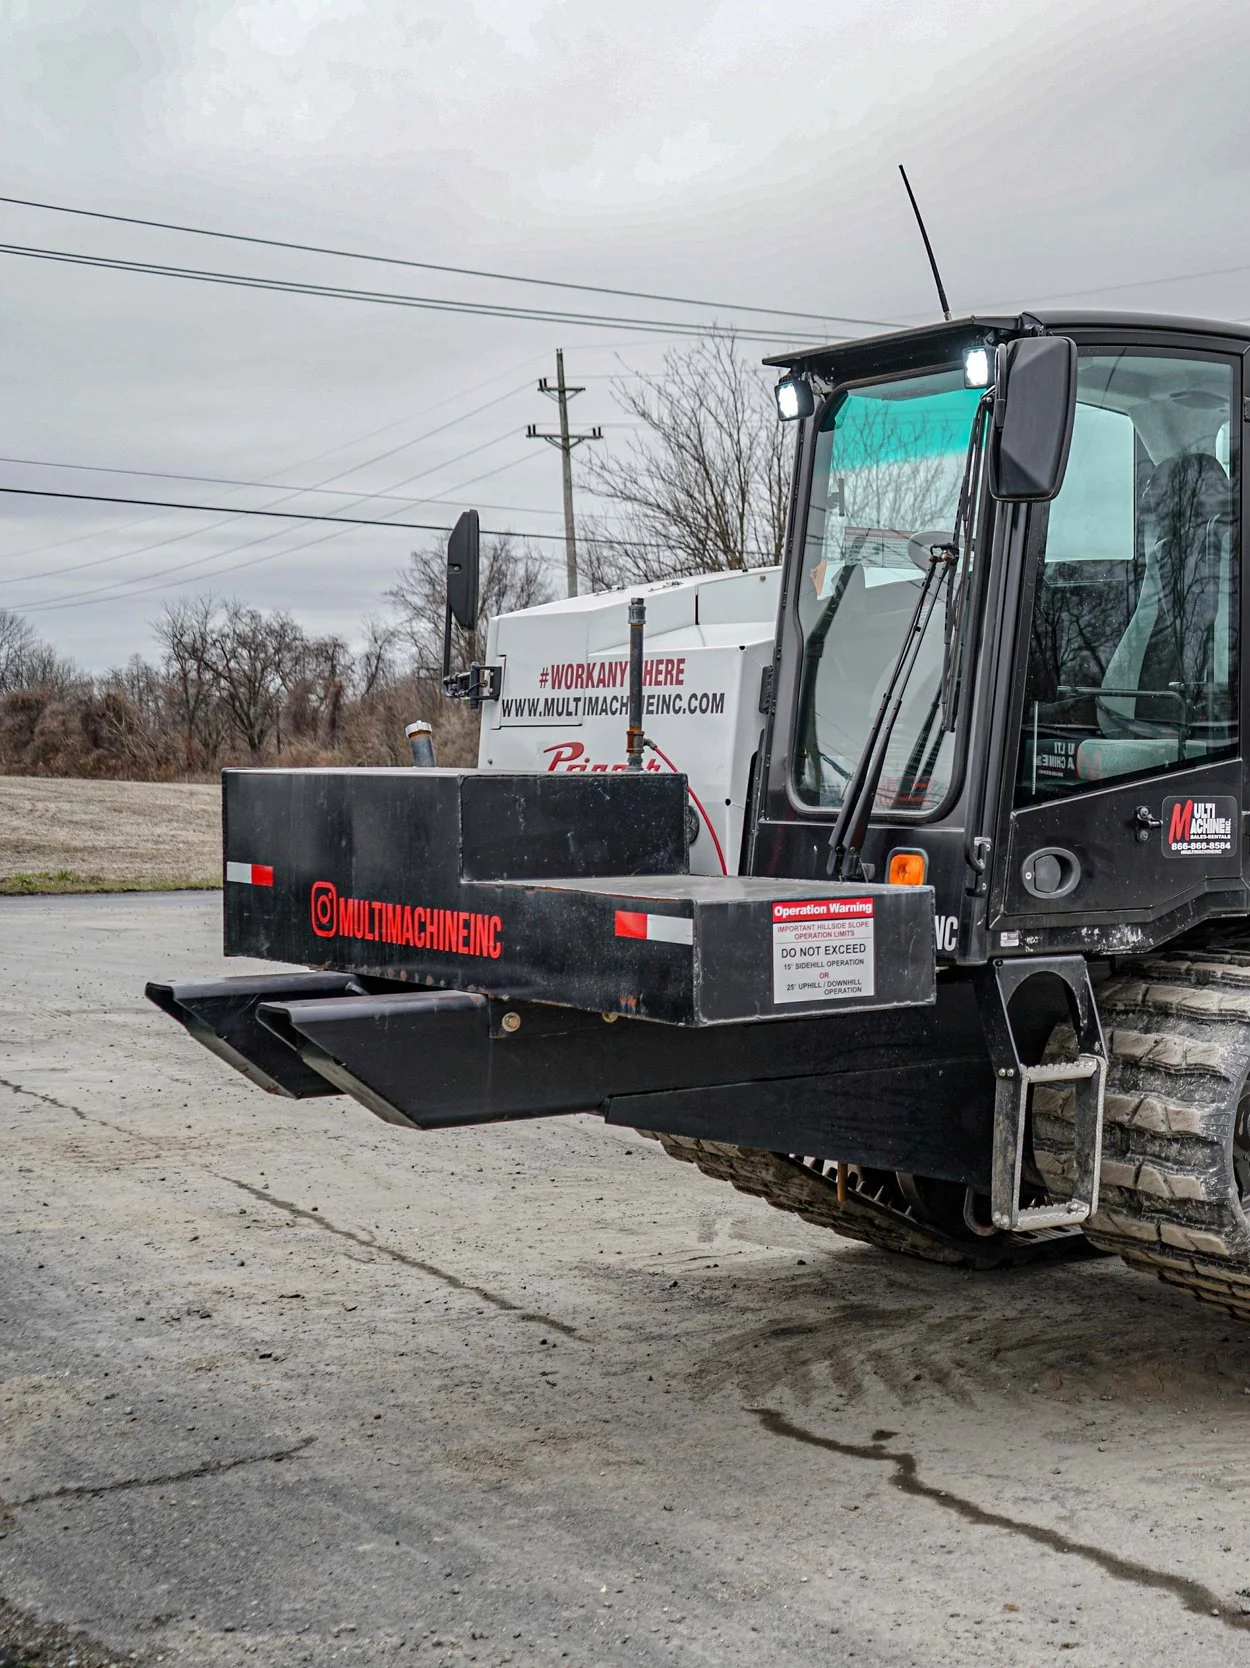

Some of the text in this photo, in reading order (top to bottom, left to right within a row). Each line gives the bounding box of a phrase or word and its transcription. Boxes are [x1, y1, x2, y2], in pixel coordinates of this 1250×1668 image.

[539, 658, 686, 690] #WORKANYHERE
[502, 693, 725, 718] WWW.MULTIMACHEINC.COM
[1171, 842, 1231, 850] 866-866-8584
[774, 902, 872, 918] Operation Warning
[339, 897, 502, 959] MULTIMACHINEINC
[777, 921, 869, 933] IMPORTANT HILLSIDE SLOPE
[795, 930, 855, 940] OPERATION LIMITS
[781, 943, 866, 958] DO NOT EXCEED
[795, 961, 825, 970] SIDEHILL
[826, 959, 864, 967] OPERATION
[798, 981, 822, 990] UPHILL
[827, 979, 862, 987] DOWNHILL
[824, 986, 862, 995] OPERATION
